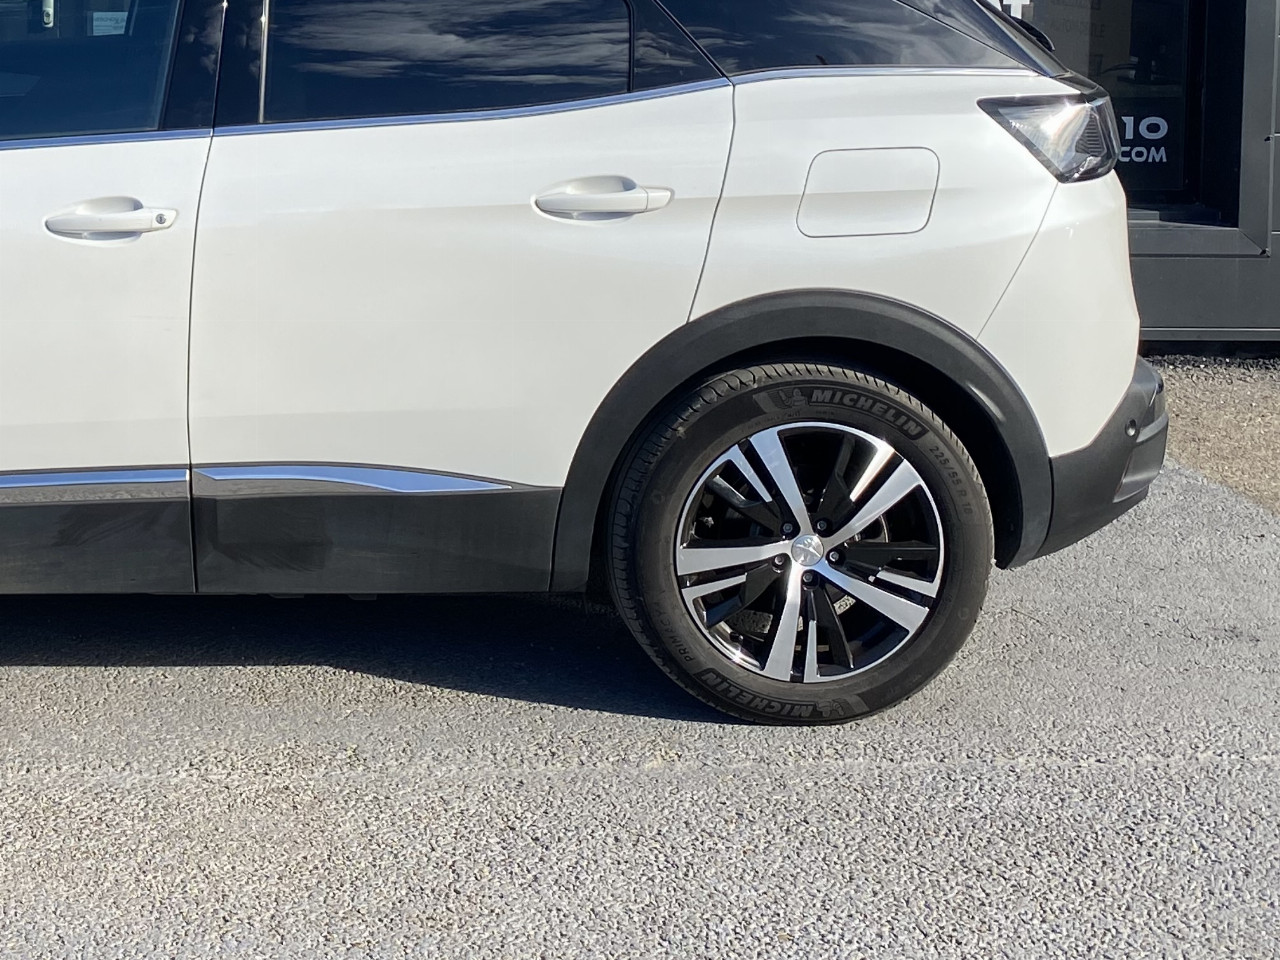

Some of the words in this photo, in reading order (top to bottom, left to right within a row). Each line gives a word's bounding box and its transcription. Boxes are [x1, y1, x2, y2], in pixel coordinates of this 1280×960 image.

[810, 389, 922, 437] MICHELIN
[928, 445, 963, 485] 225/55
[701, 671, 814, 719] MICHELIN
